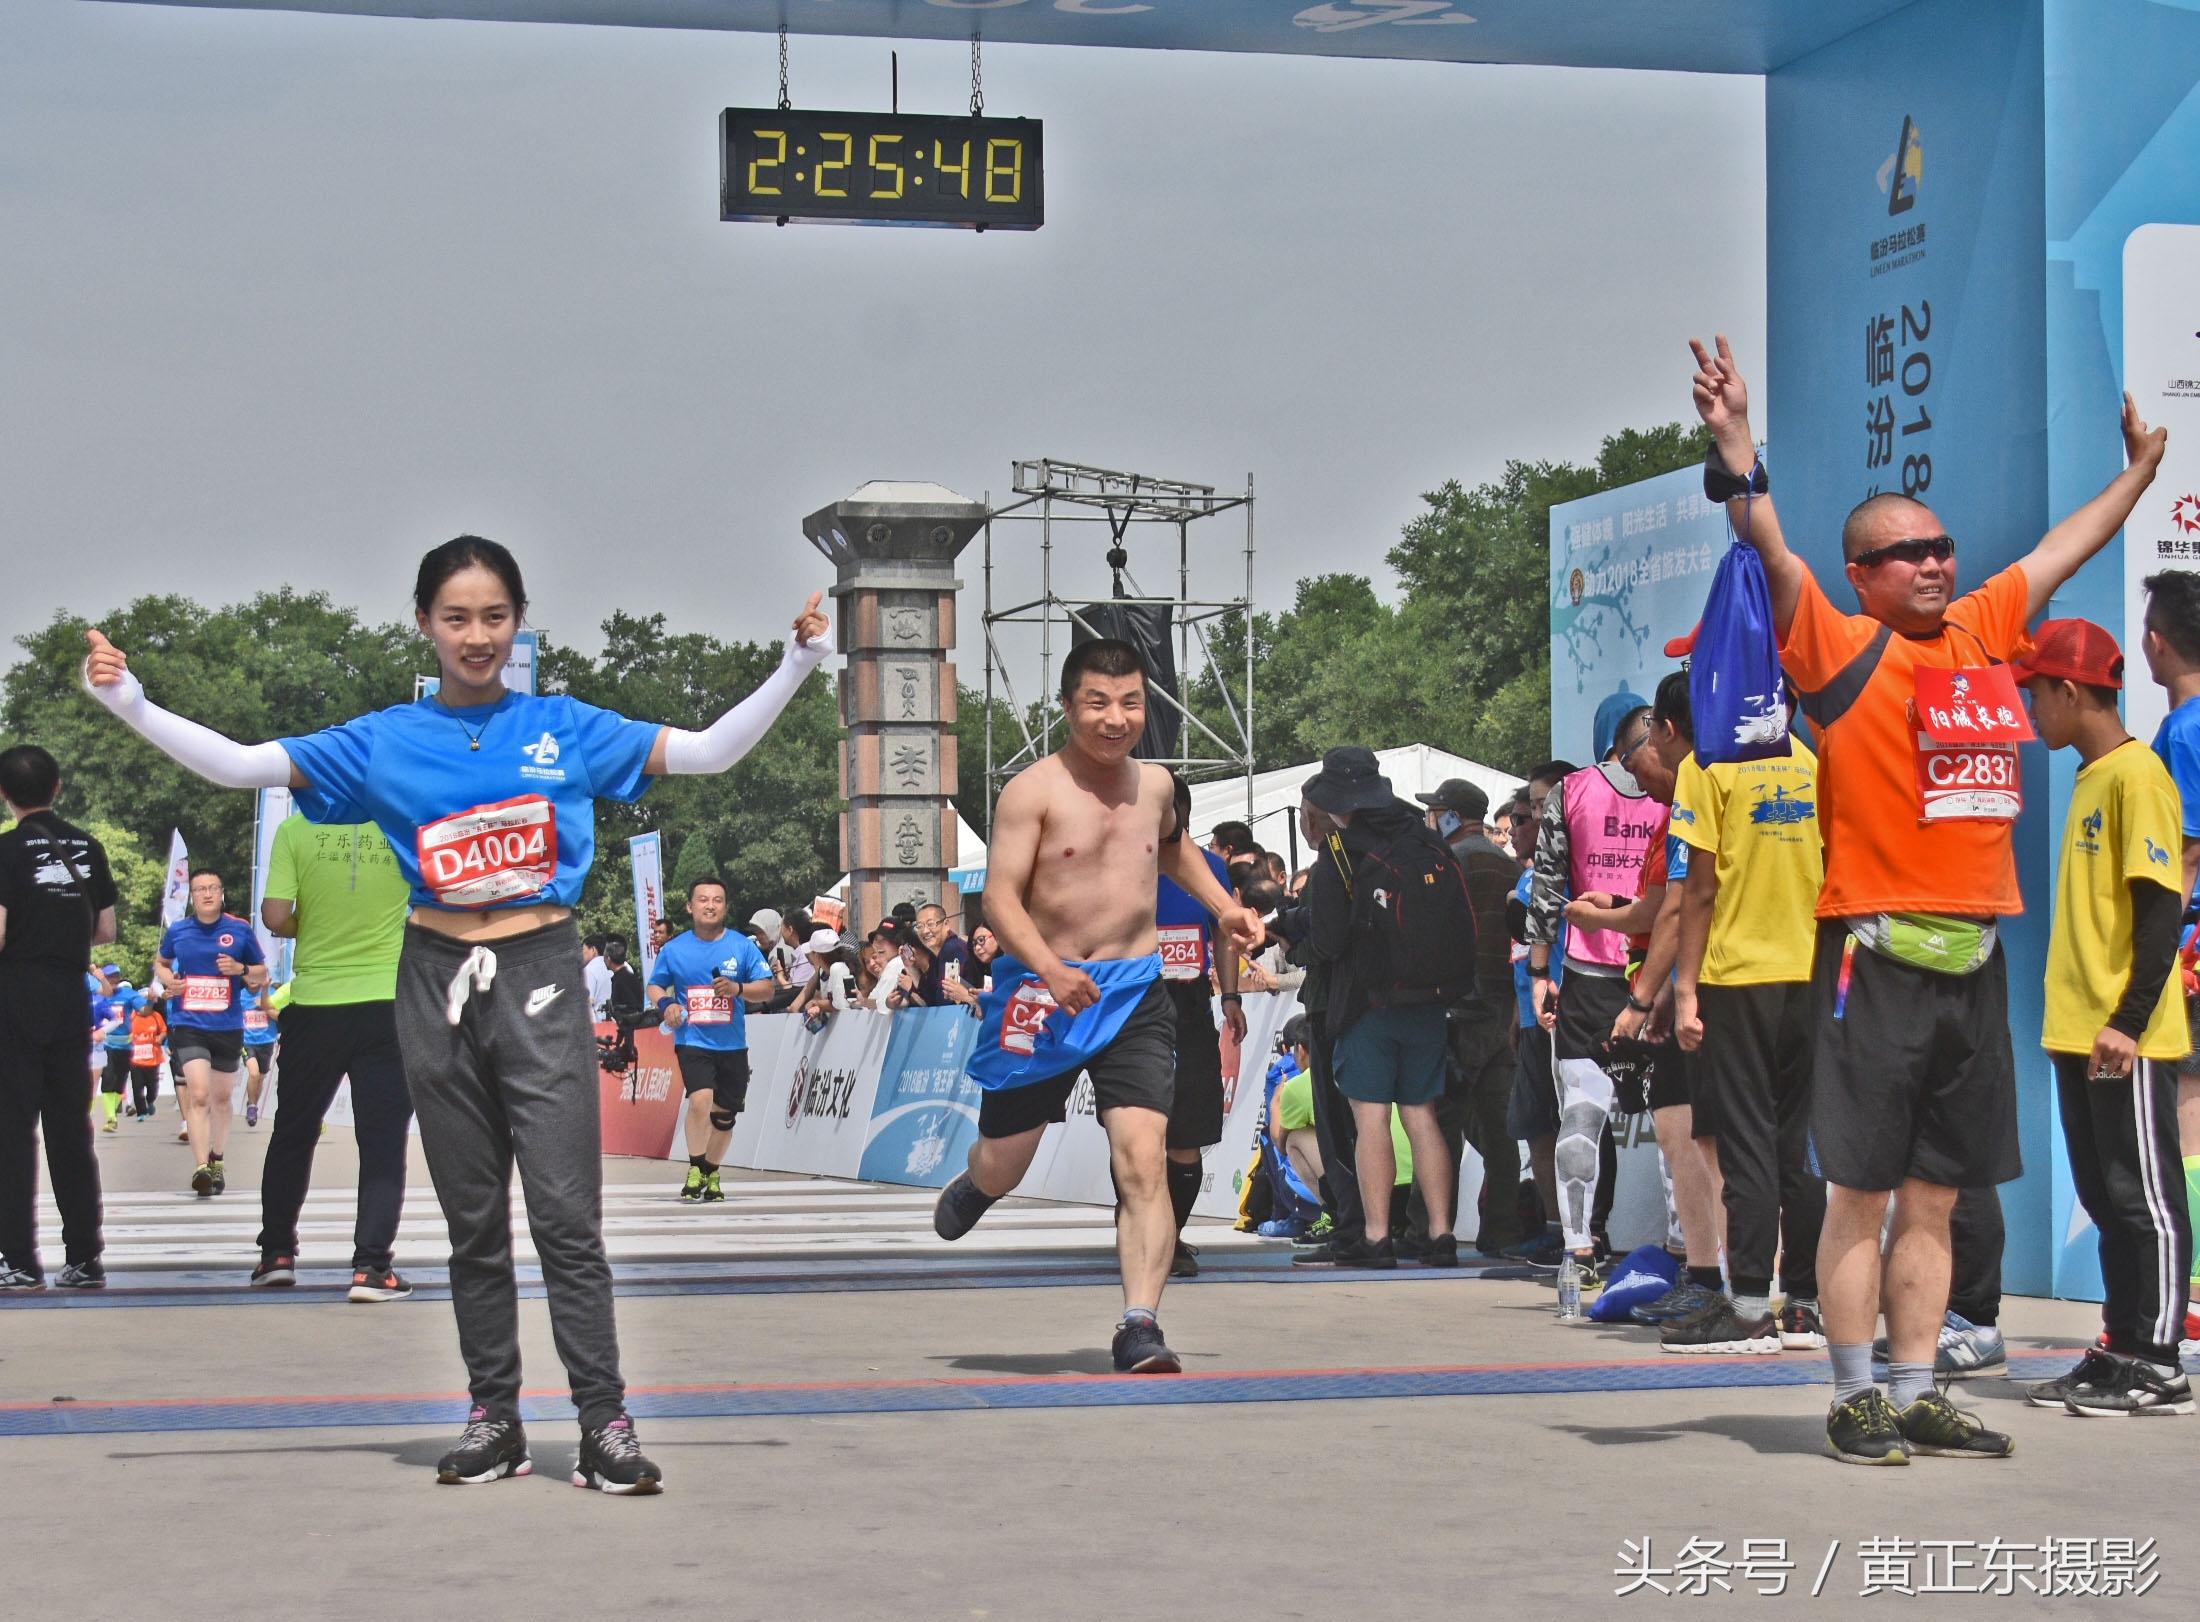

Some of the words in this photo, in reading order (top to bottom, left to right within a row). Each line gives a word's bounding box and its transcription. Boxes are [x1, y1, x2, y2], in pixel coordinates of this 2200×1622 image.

[749, 130, 1022, 202] 2:25:48
[1870, 224, 1926, 261] 临汾马拉松赛
[1870, 259, 1891, 278] LINFEN
[1891, 248, 1926, 272] MARATHON
[1901, 300, 1932, 498] 2018
[1622, 502, 1667, 537] 阳光生活
[1583, 541, 1713, 596] 助力2018全省旅发大会
[1928, 754, 2014, 786] C2837
[315, 832, 392, 850] 宁乐药业
[1604, 816, 1655, 839] Bank
[433, 827, 548, 881] D4004
[188, 987, 228, 999] C2782
[690, 997, 729, 1010] C3428
[803, 1068, 857, 1119] 临汾文化
